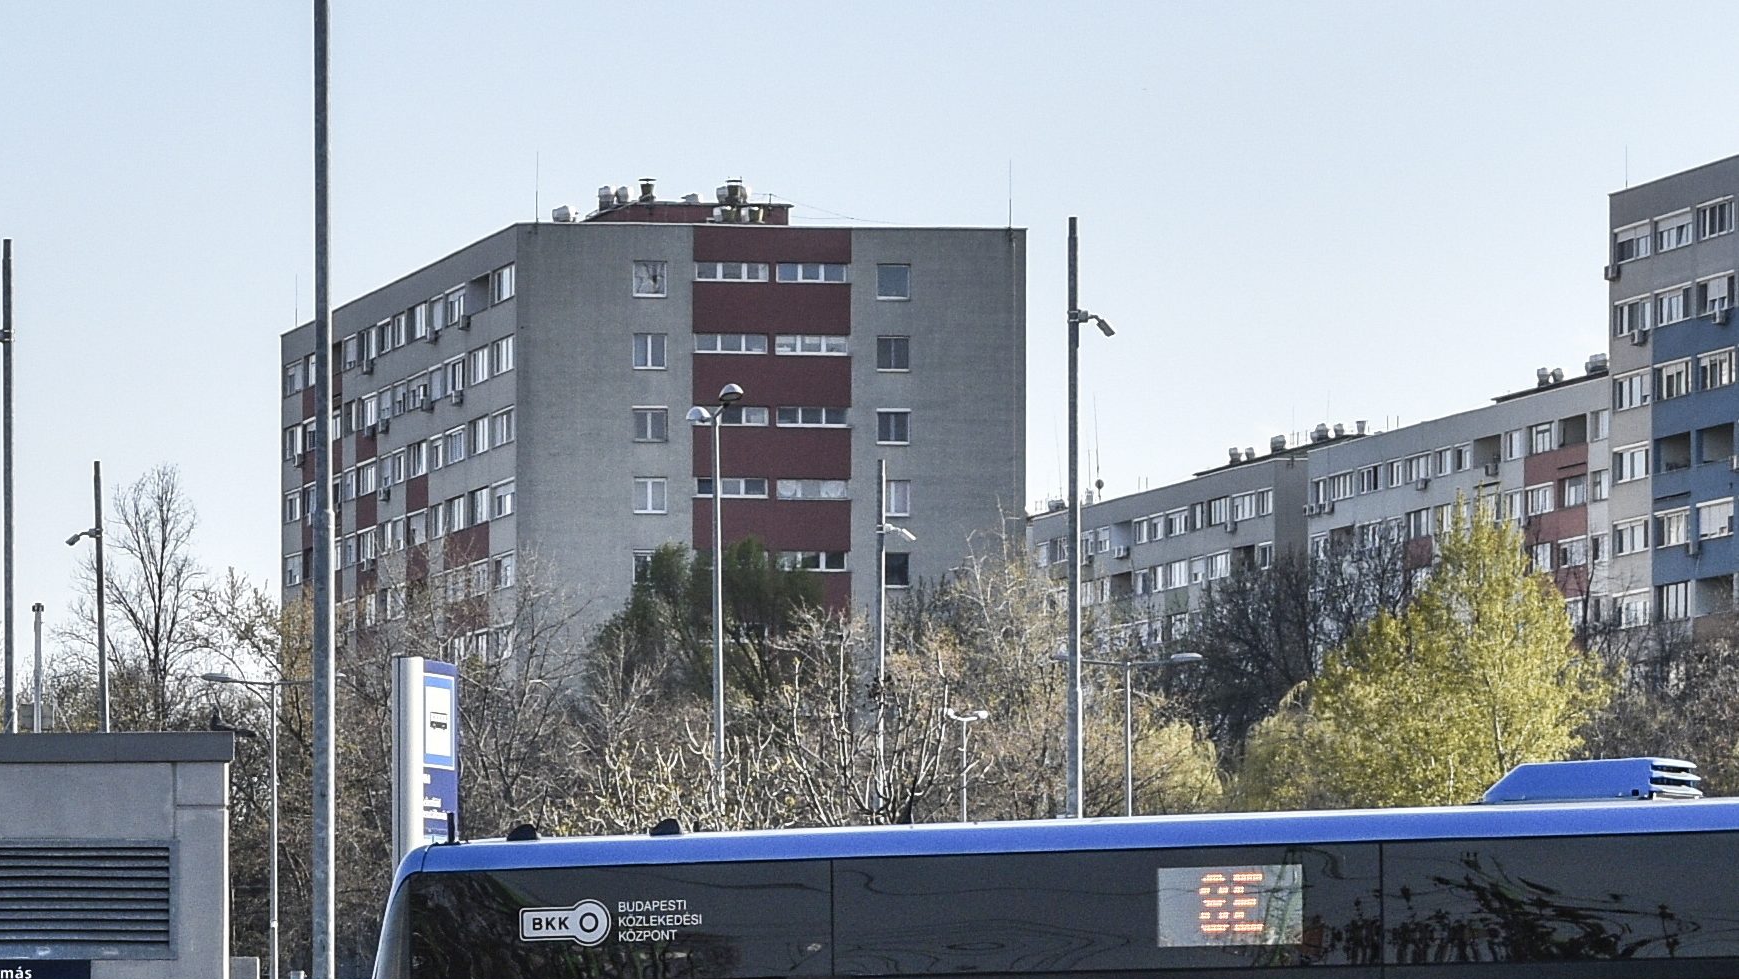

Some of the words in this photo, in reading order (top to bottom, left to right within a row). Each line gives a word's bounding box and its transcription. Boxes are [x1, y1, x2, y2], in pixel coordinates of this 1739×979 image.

[618, 900, 687, 913] BUDAPESTI
[532, 917, 570, 931] BKK
[618, 912, 703, 927] KÖZLEKEDÉSI
[618, 928, 678, 942] KÖZPONT
